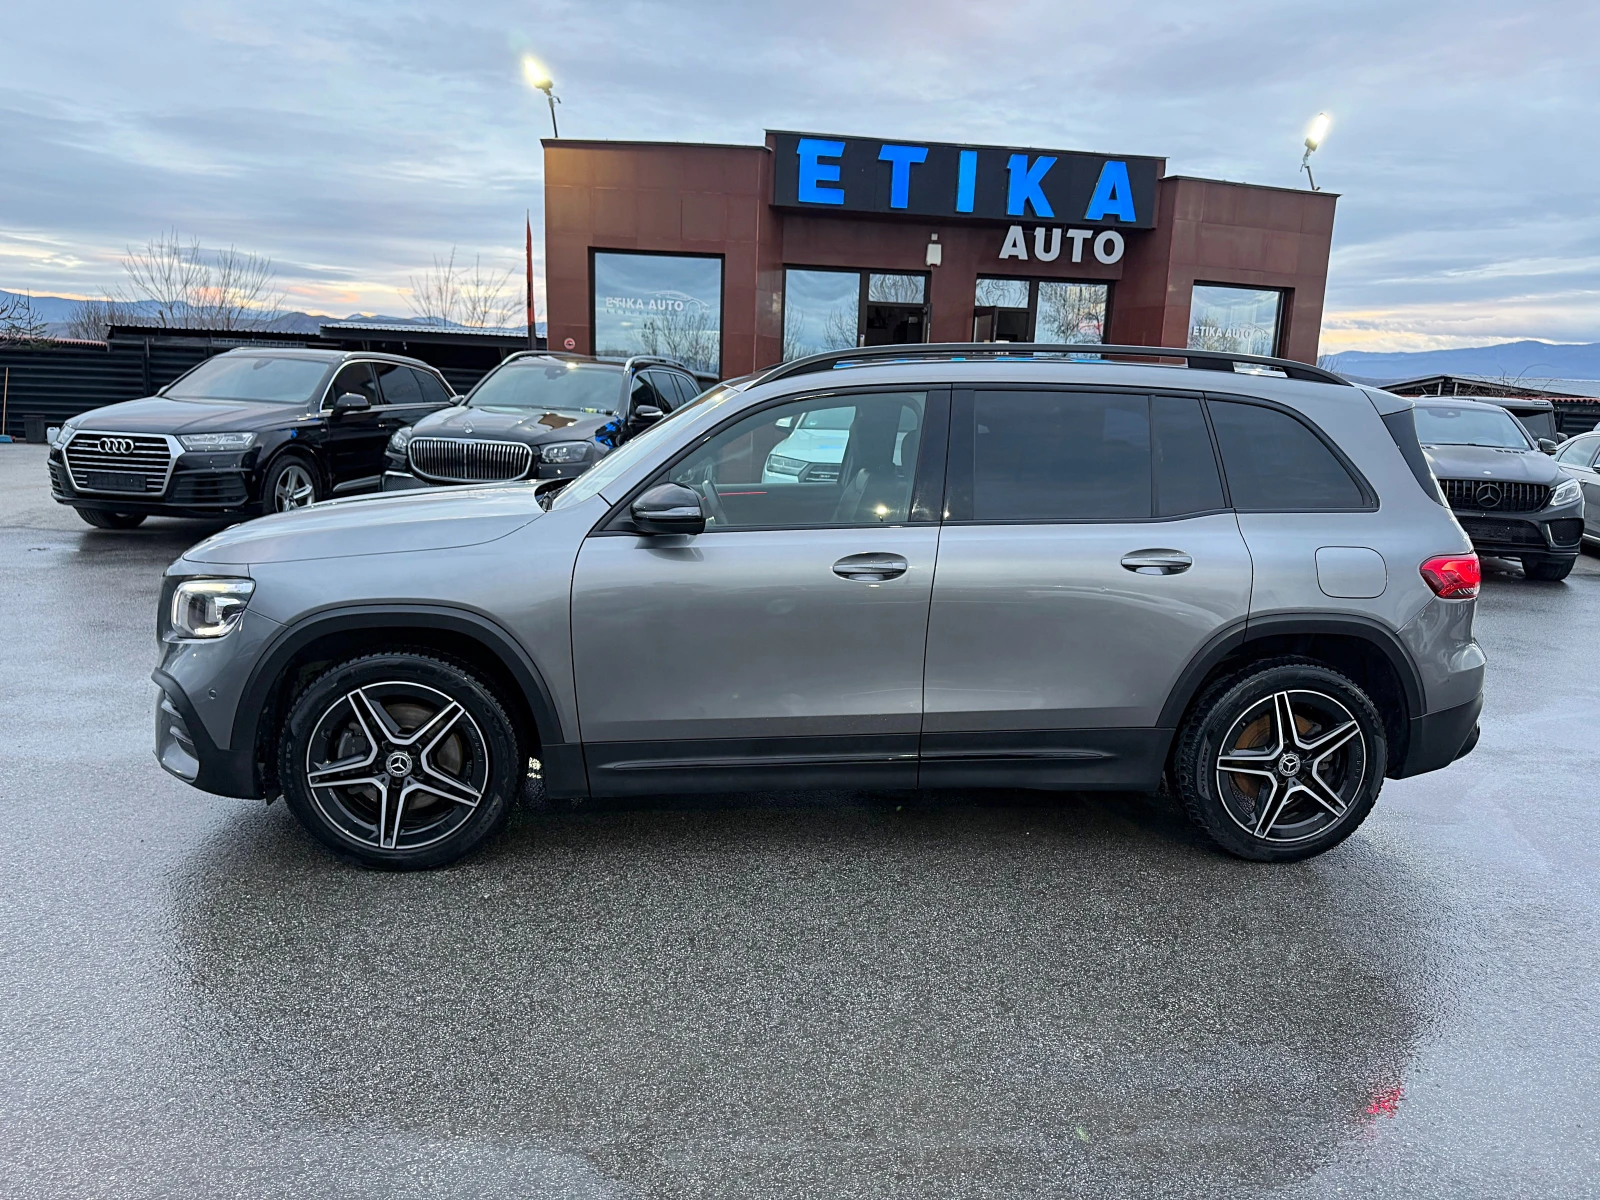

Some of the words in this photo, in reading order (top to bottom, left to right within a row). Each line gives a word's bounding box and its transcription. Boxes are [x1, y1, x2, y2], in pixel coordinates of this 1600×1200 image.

[796, 138, 1136, 223] ETIKA
[999, 225, 1125, 265] AUTO
[605, 297, 644, 309] ETIKA
[648, 299, 684, 311] AUTO
[1193, 326, 1223, 337] ETIKA
